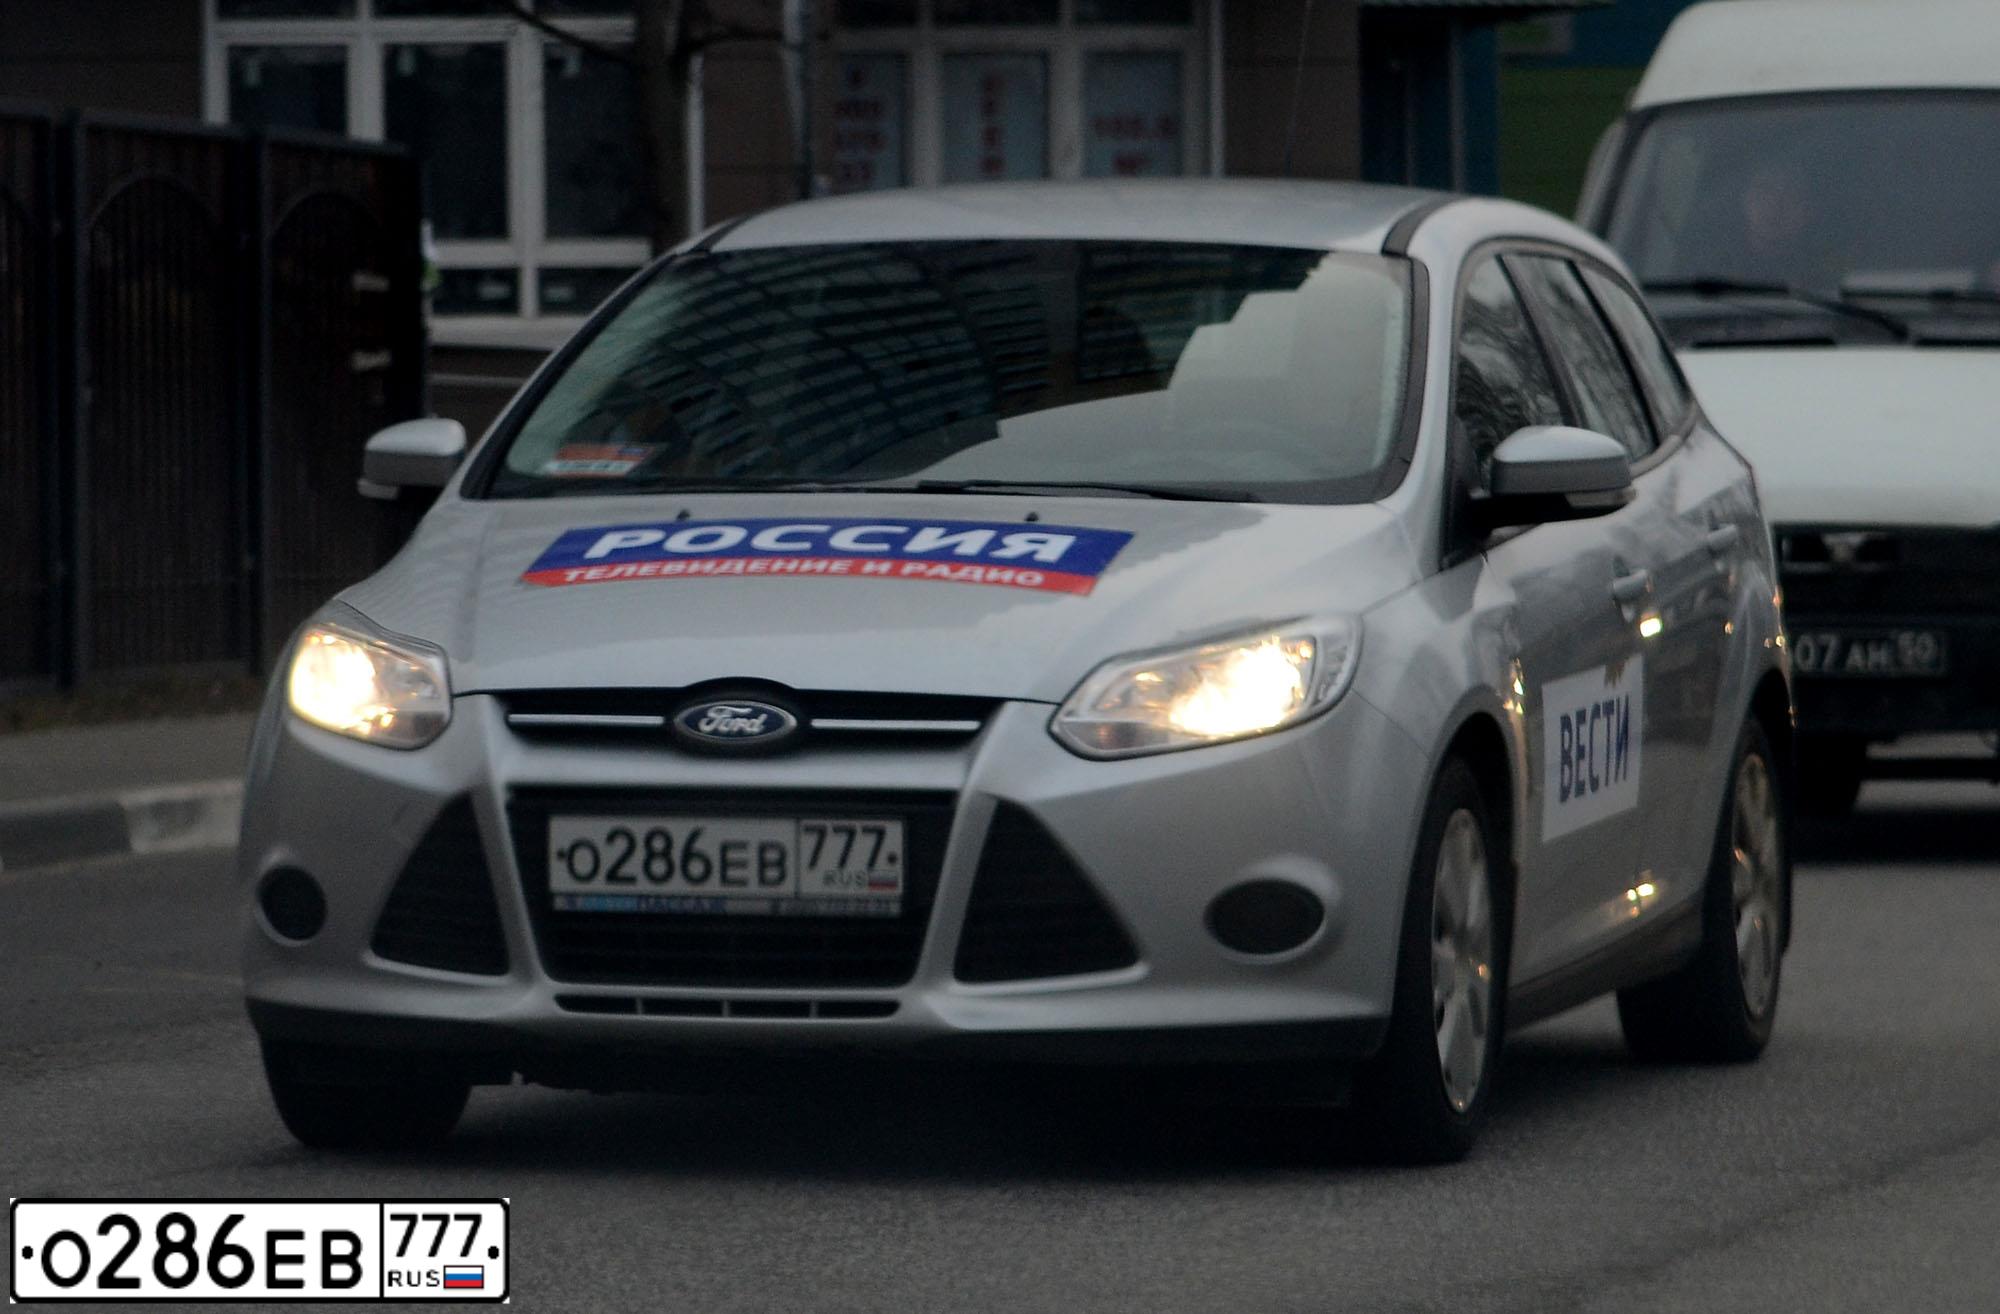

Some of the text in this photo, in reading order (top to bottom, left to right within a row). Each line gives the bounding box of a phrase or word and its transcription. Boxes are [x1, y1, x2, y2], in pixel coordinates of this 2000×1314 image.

[583, 523, 1077, 563] РОССИЯ
[562, 557, 1046, 588] ТЕЛЕВИДЕНИЕ И РАДИО
[697, 705, 769, 735] Ford
[1559, 694, 1630, 804] ВЕСТИ
[566, 824, 887, 887] О286ЕВ 777
[823, 870, 866, 887] RUS
